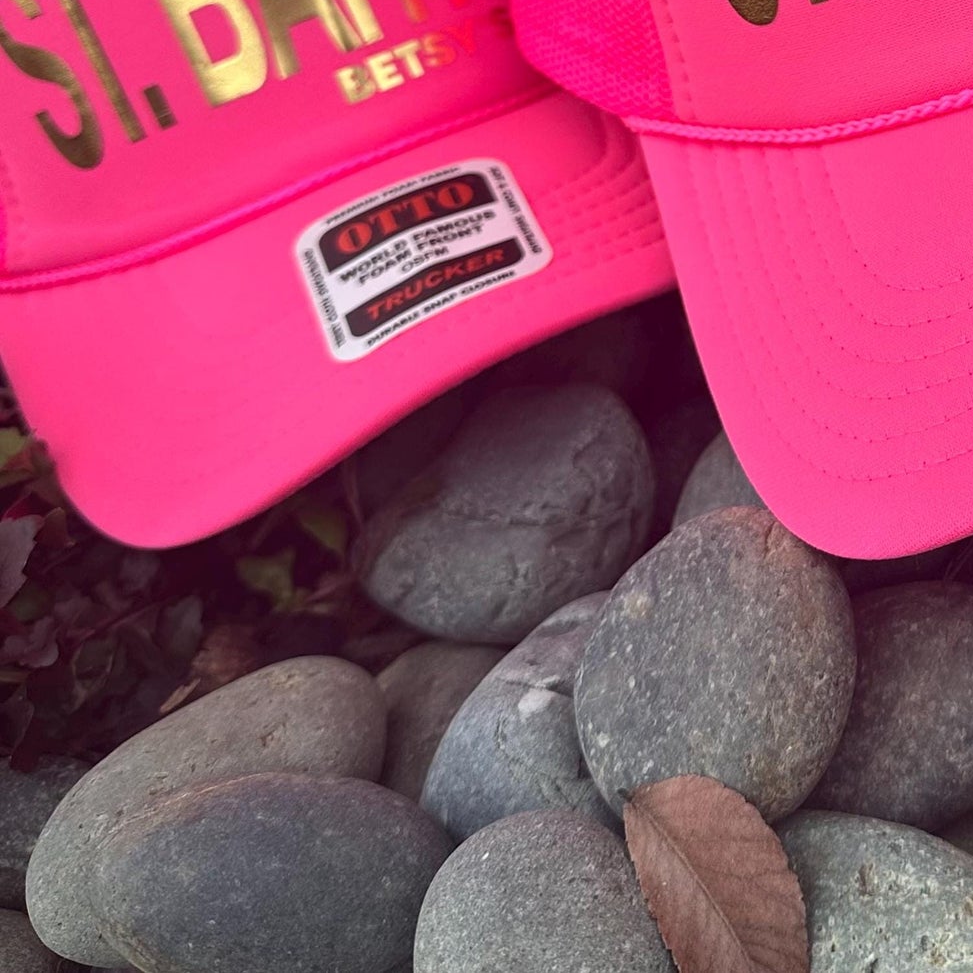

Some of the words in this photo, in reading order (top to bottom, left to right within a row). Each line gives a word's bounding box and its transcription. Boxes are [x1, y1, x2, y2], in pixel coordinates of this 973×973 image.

[335, 181, 474, 255] OTTO
[338, 239, 410, 282] WORLD
[358, 249, 412, 286] FOAM
[366, 248, 506, 321] TRUCKER
